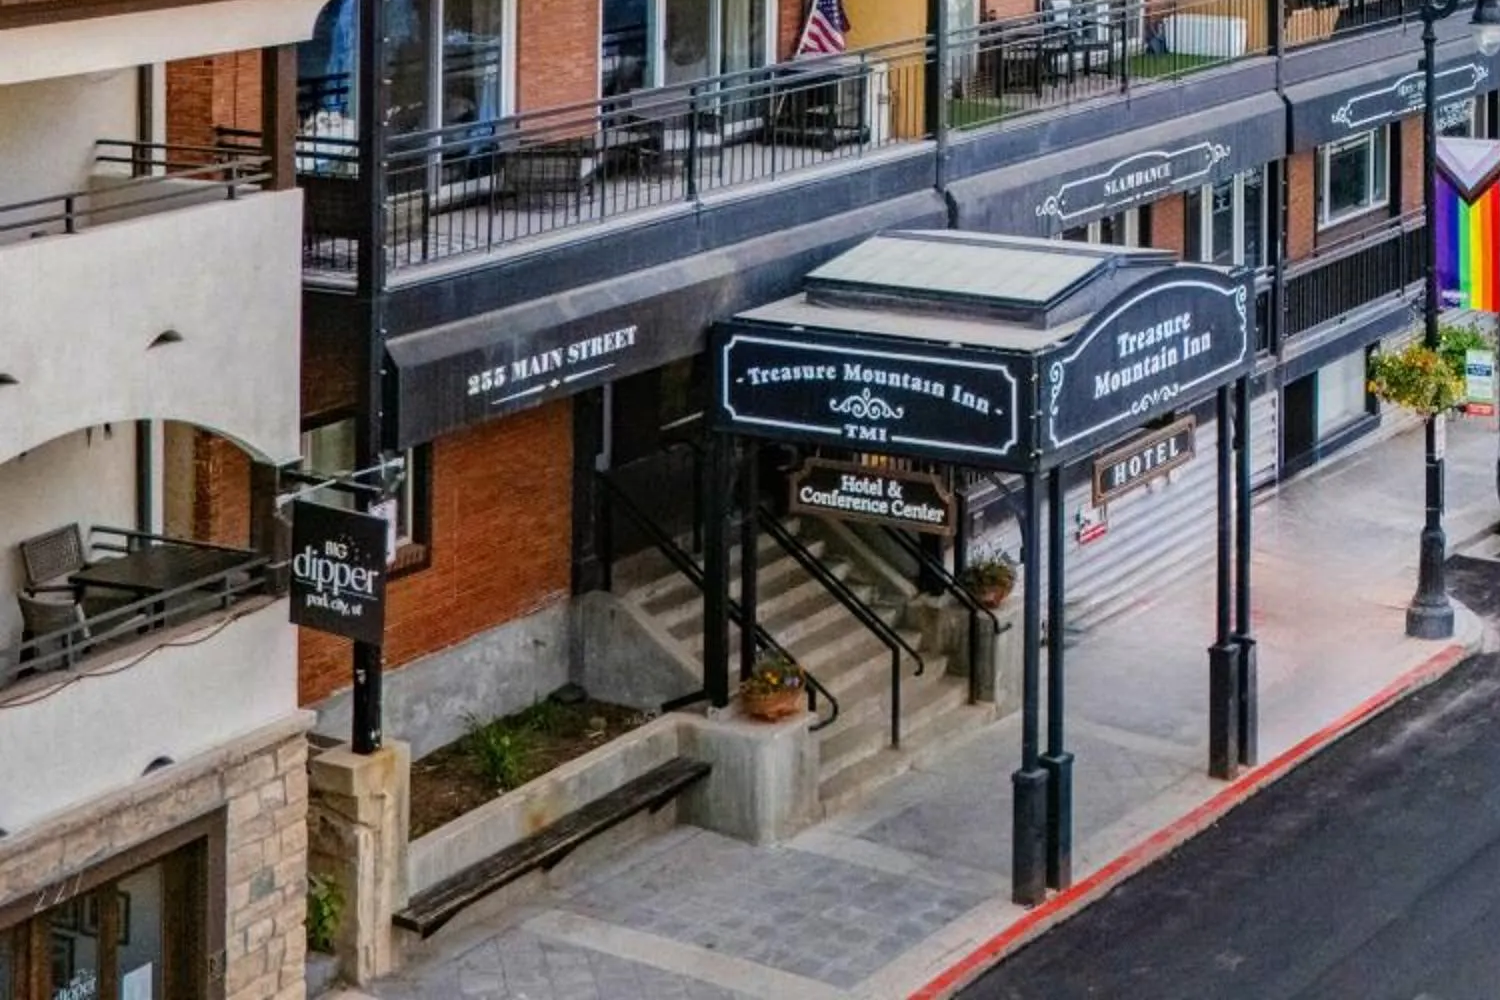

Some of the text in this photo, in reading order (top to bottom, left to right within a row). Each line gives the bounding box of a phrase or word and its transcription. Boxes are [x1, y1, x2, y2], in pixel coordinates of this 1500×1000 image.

[510, 347, 564, 380] MAIN
[567, 325, 639, 365] STREET
[1117, 311, 1192, 358] Treasure
[748, 363, 990, 416] Treasure Mountain Inn
[1093, 331, 1212, 400] Mountain Inn
[845, 423, 888, 443] TMI
[1113, 437, 1180, 486] HOTEL
[799, 486, 945, 523] Conference Center
[841, 474, 903, 499] Hotel &
[293, 545, 380, 596] dipper
[325, 541, 348, 559] BIG
